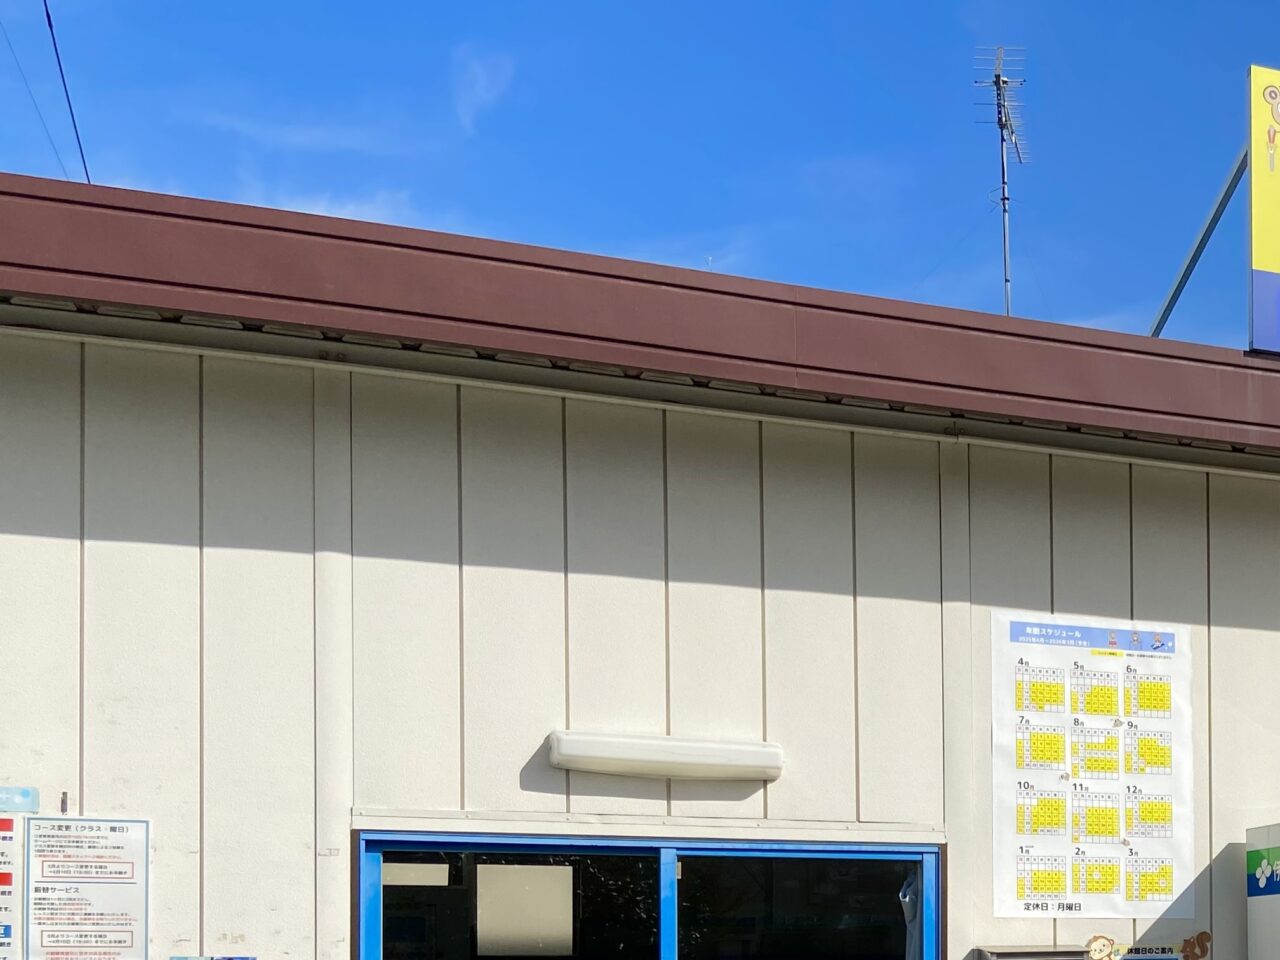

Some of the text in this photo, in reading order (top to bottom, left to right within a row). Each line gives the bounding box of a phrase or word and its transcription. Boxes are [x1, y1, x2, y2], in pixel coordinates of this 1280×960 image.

[1017, 657, 1138, 674] 4月 5月 6月
[1018, 716, 1138, 731] 7月 8月 9月
[1017, 781, 1143, 795] 10月 11月 12月
[1018, 846, 1139, 857] 1月 2月 3月
[1024, 903, 1082, 911] 定休日：月曜日
